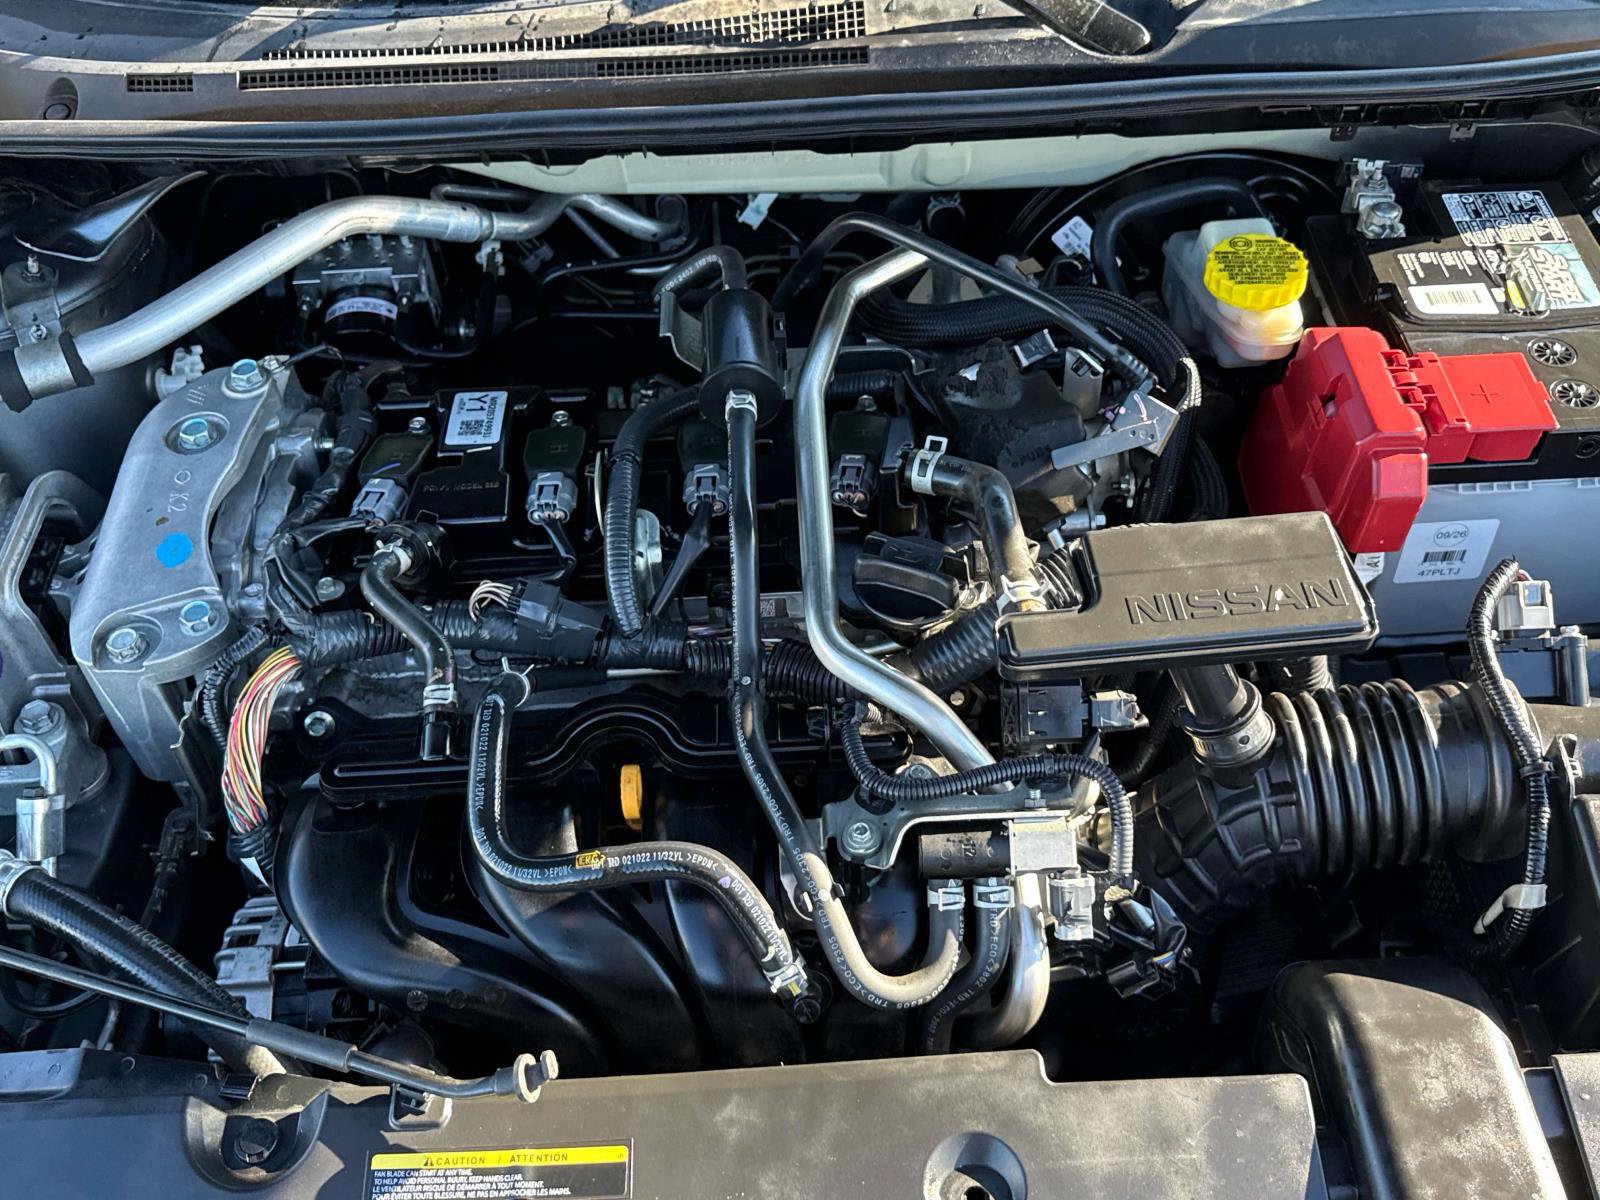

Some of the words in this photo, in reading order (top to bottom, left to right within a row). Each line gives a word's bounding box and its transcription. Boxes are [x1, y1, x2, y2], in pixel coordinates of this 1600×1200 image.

[466, 394, 489, 412] Y1
[1435, 530, 1468, 540] 09/26
[1417, 567, 1461, 577] 47PLTJ
[1124, 578, 1350, 624] NISSAN
[478, 722, 490, 751] 021022
[622, 854, 651, 865] 021022
[750, 905, 773, 935] 021022
[436, 1156, 486, 1166] CAUTION
[509, 1153, 568, 1163] ATTENTION
